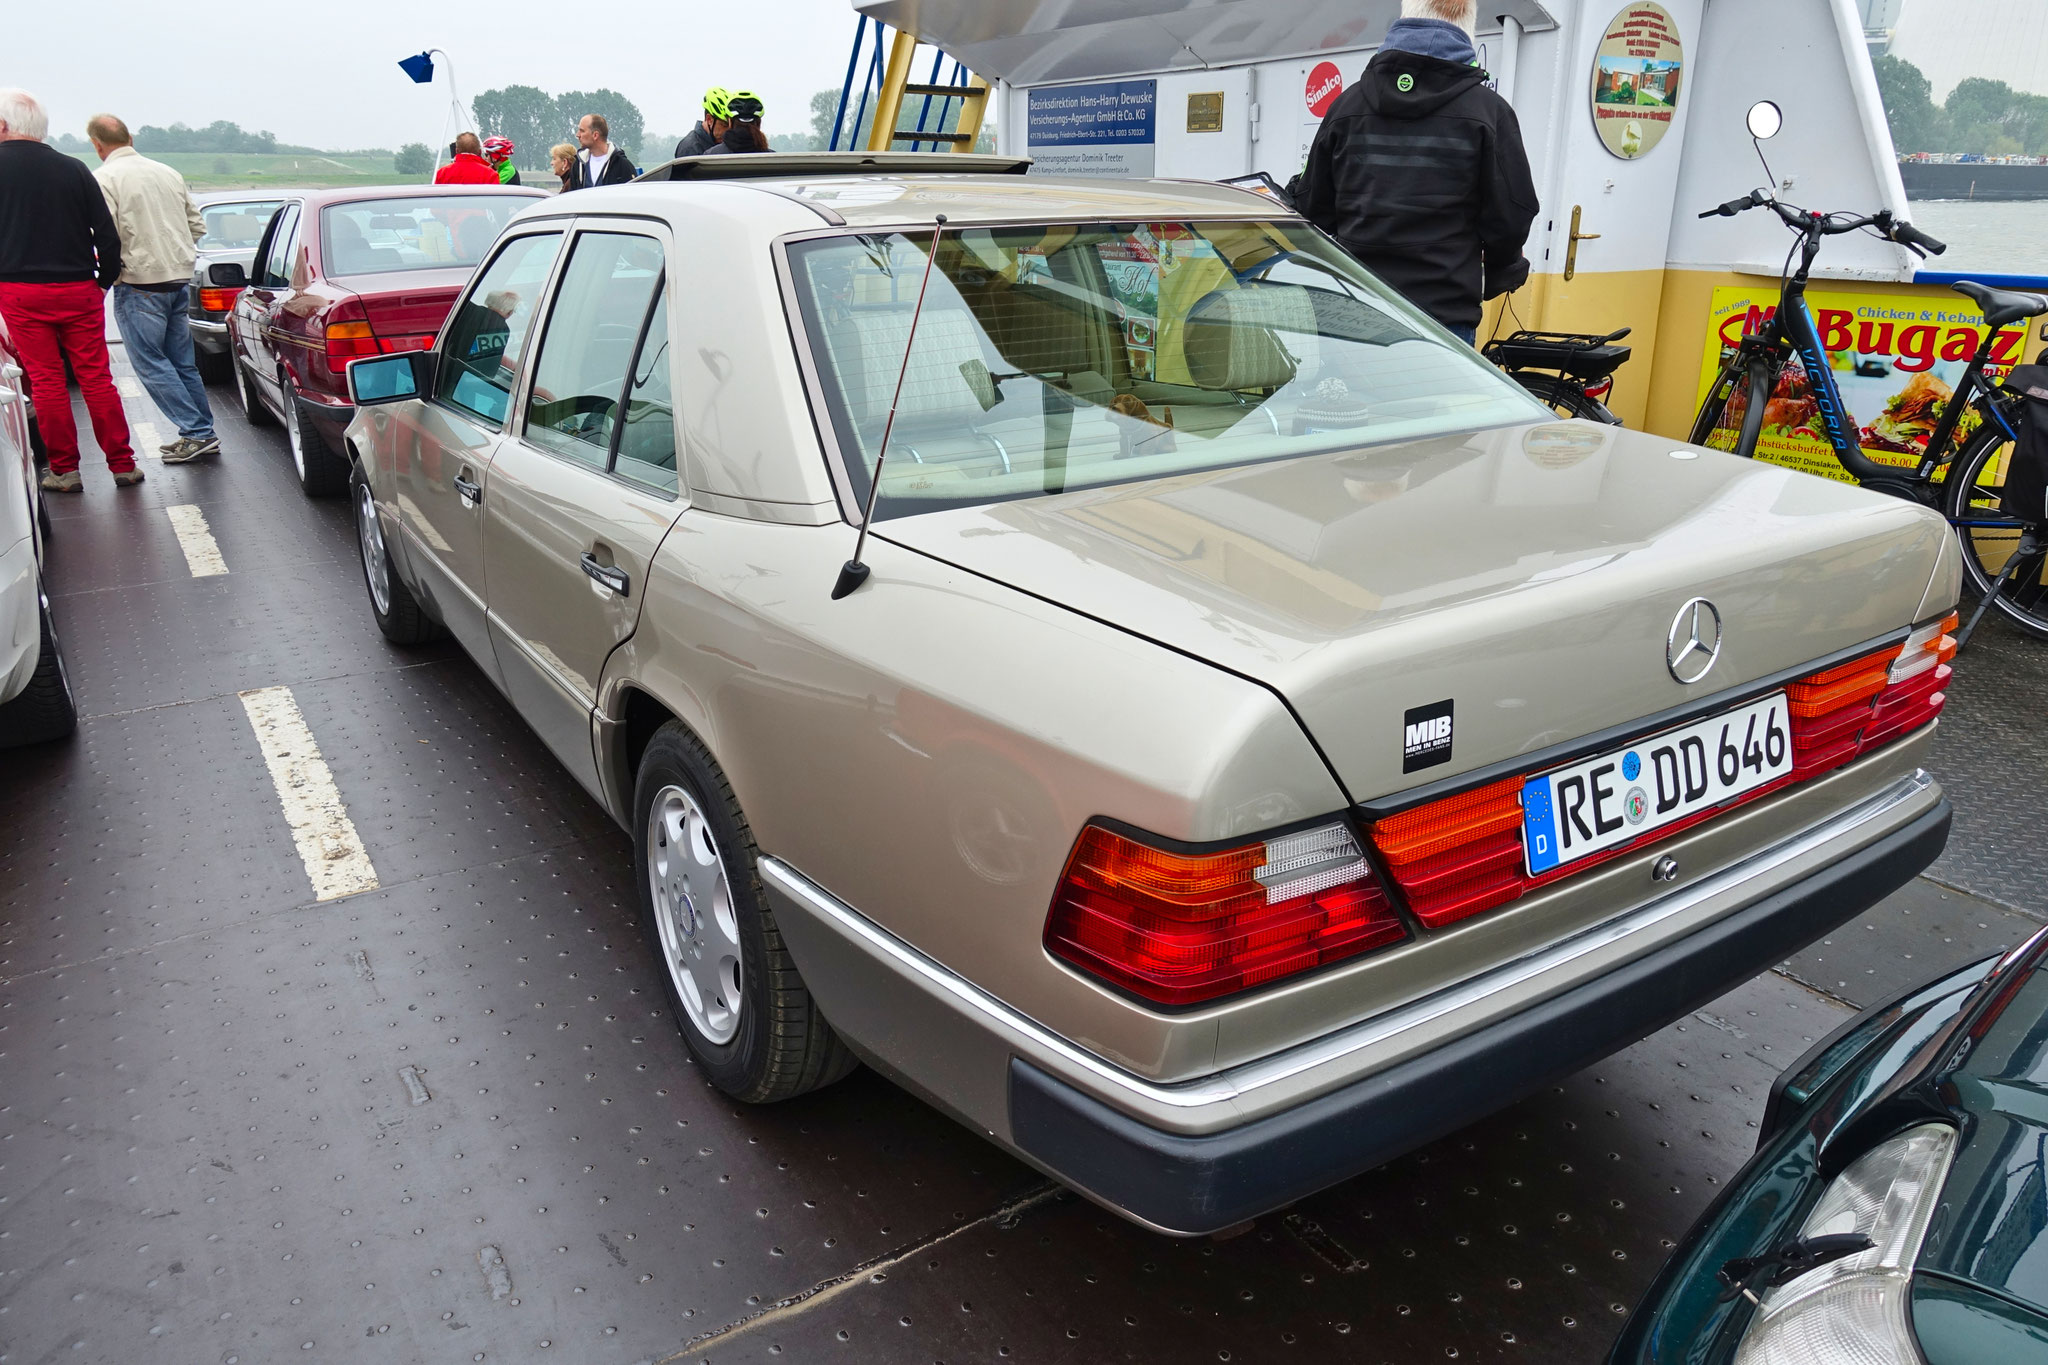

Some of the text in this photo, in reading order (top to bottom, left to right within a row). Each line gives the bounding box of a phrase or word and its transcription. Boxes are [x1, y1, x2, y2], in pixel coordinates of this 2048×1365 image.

[1030, 91, 1153, 110] Bezirksdirektion Hans-Harry Dewuske
[1306, 74, 1341, 108] Sinalco
[1030, 112, 1095, 126] Versicherungs-Agentur
[1097, 111, 1116, 122] GmbH
[1135, 108, 1146, 120] KG
[1082, 153, 1103, 163] Dominik
[1105, 153, 1124, 162] Treeter
[1117, 265, 1159, 302] Hof
[1714, 299, 1750, 316] seit 1989
[1857, 306, 1915, 320] Chicken
[1919, 310, 1933, 321] &
[1817, 308, 2025, 373] Bugaz
[1802, 348, 1848, 450] VICTORIA
[1755, 437, 1828, 455] ühstücksbuffet
[1868, 455, 1887, 464] von
[1890, 456, 1912, 468] 8.00
[1780, 454, 1802, 464] 46537
[1803, 458, 1841, 470] Dinslaken
[1839, 473, 1850, 481] Sa
[1405, 715, 1452, 747] MIB
[1405, 736, 1451, 754] MEN IN BENZ
[1536, 834, 1548, 855] D
[1557, 762, 1624, 848] RE
[1651, 735, 1708, 815] DD
[1717, 706, 1785, 787] 646
